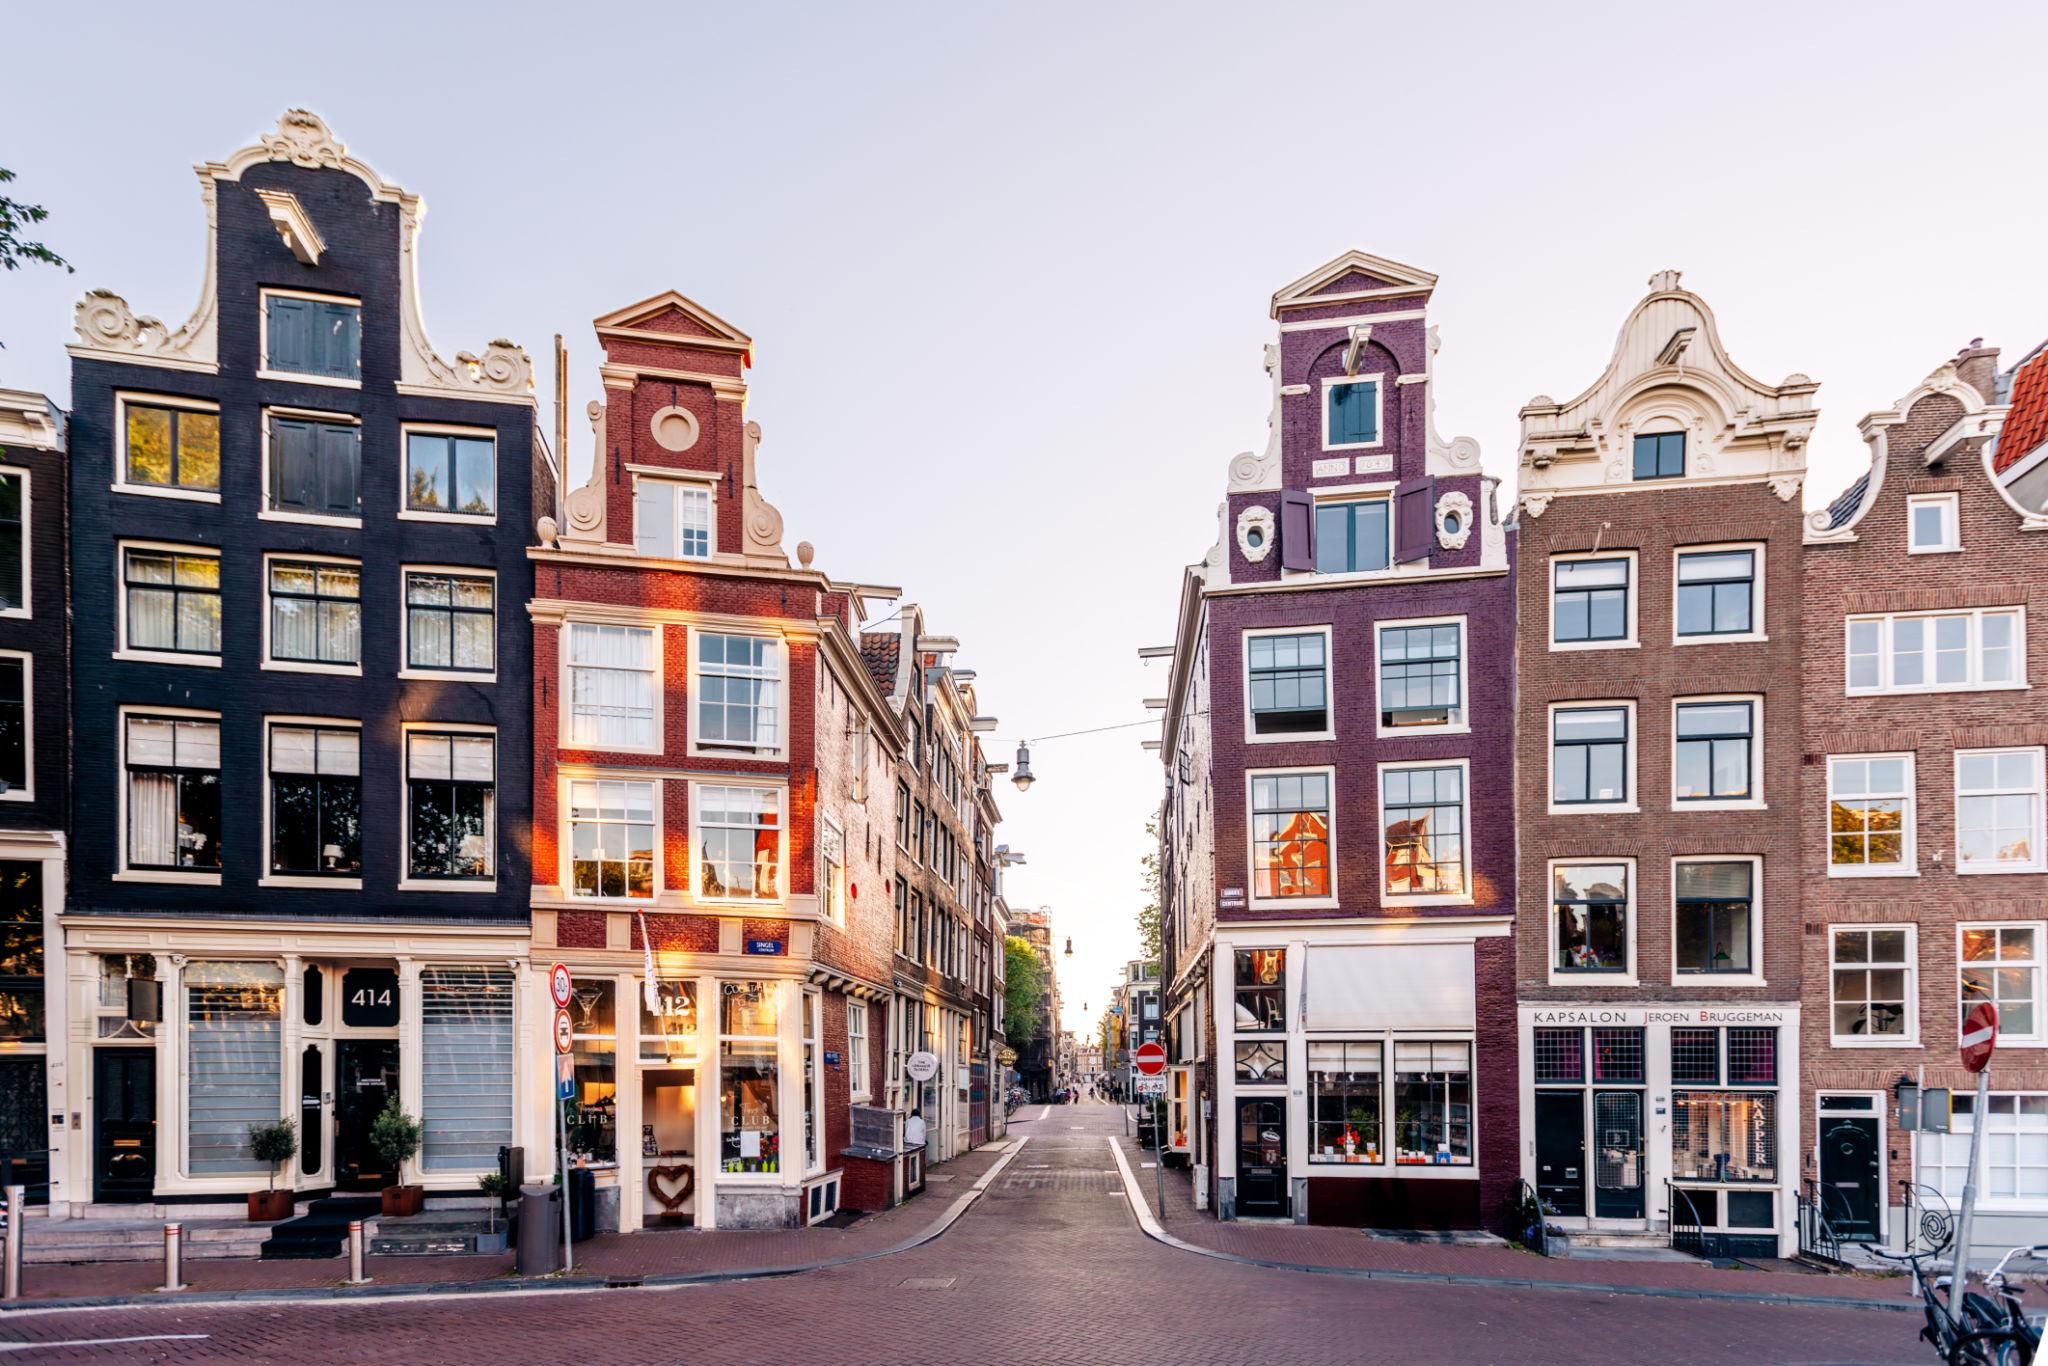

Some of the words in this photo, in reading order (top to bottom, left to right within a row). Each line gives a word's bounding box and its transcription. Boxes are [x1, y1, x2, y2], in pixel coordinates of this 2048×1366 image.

[756, 941, 775, 949] SINGEL
[351, 988, 392, 1007] 414
[655, 996, 690, 1017] 12
[1534, 1012, 1627, 1023] KAPSALON
[1643, 1011, 1690, 1025] JEROEN
[1699, 1011, 1783, 1022] BRUGGEMAN
[731, 1115, 770, 1126] CLUB
[1752, 1098, 1766, 1164] KAPPER
